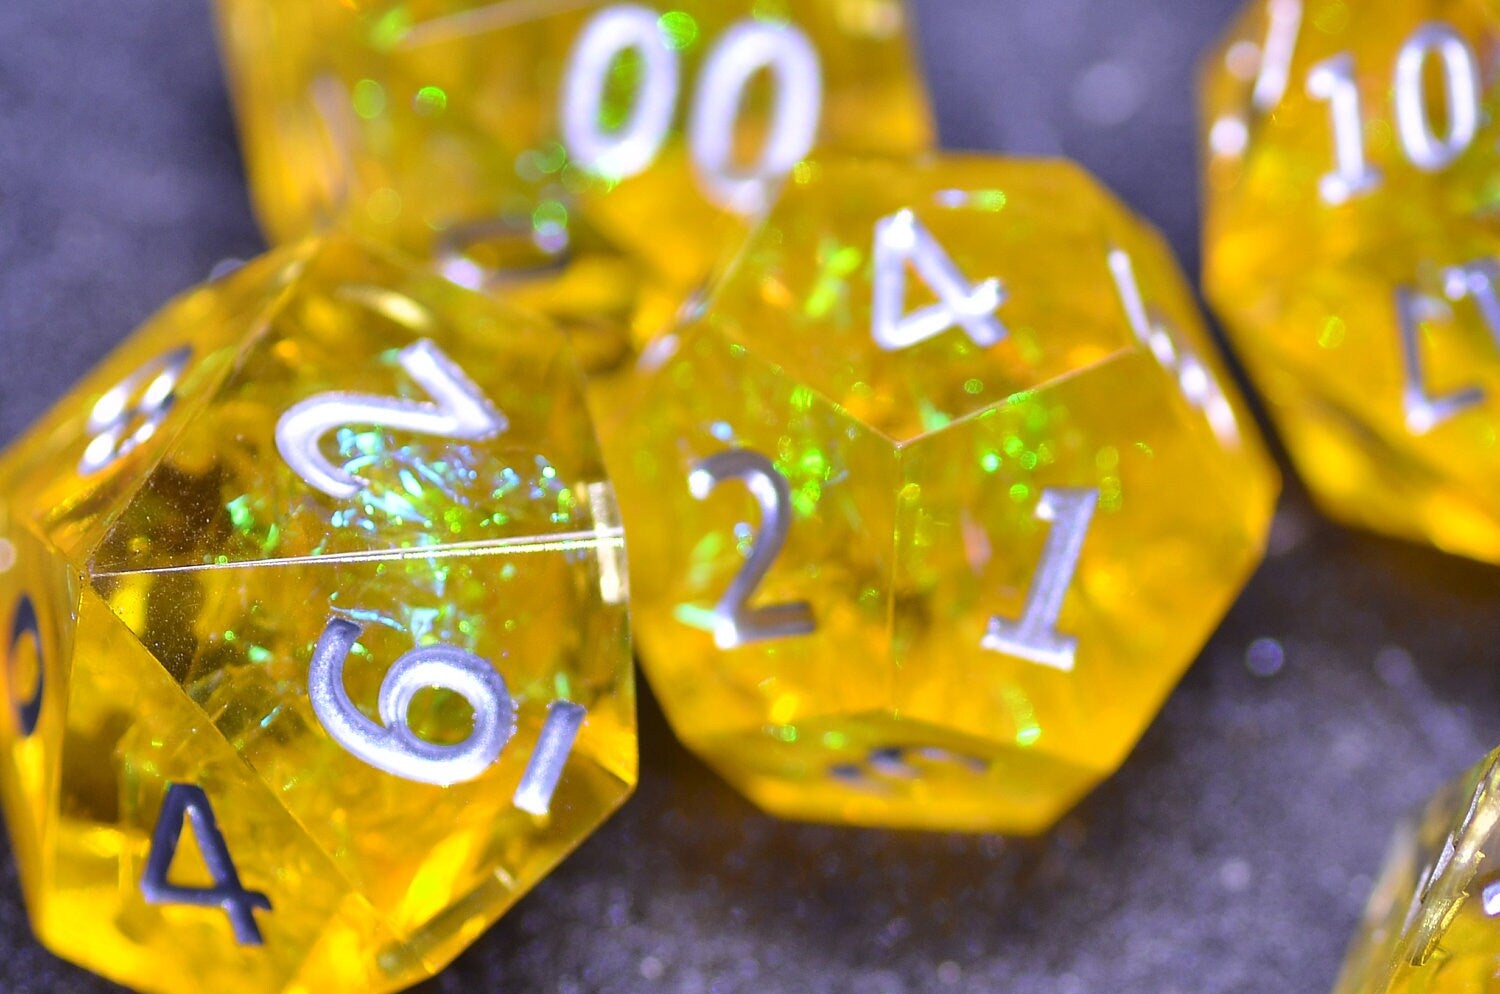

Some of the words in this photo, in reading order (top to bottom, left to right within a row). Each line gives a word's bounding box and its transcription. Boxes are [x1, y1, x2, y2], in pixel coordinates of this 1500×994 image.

[562, 5, 822, 222] 00
[1305, 22, 1481, 206] 10
[870, 208, 1006, 350] 4
[274, 338, 508, 498] 2
[688, 448, 817, 650] 2
[981, 486, 1100, 672] 1
[140, 782, 272, 945] 4
